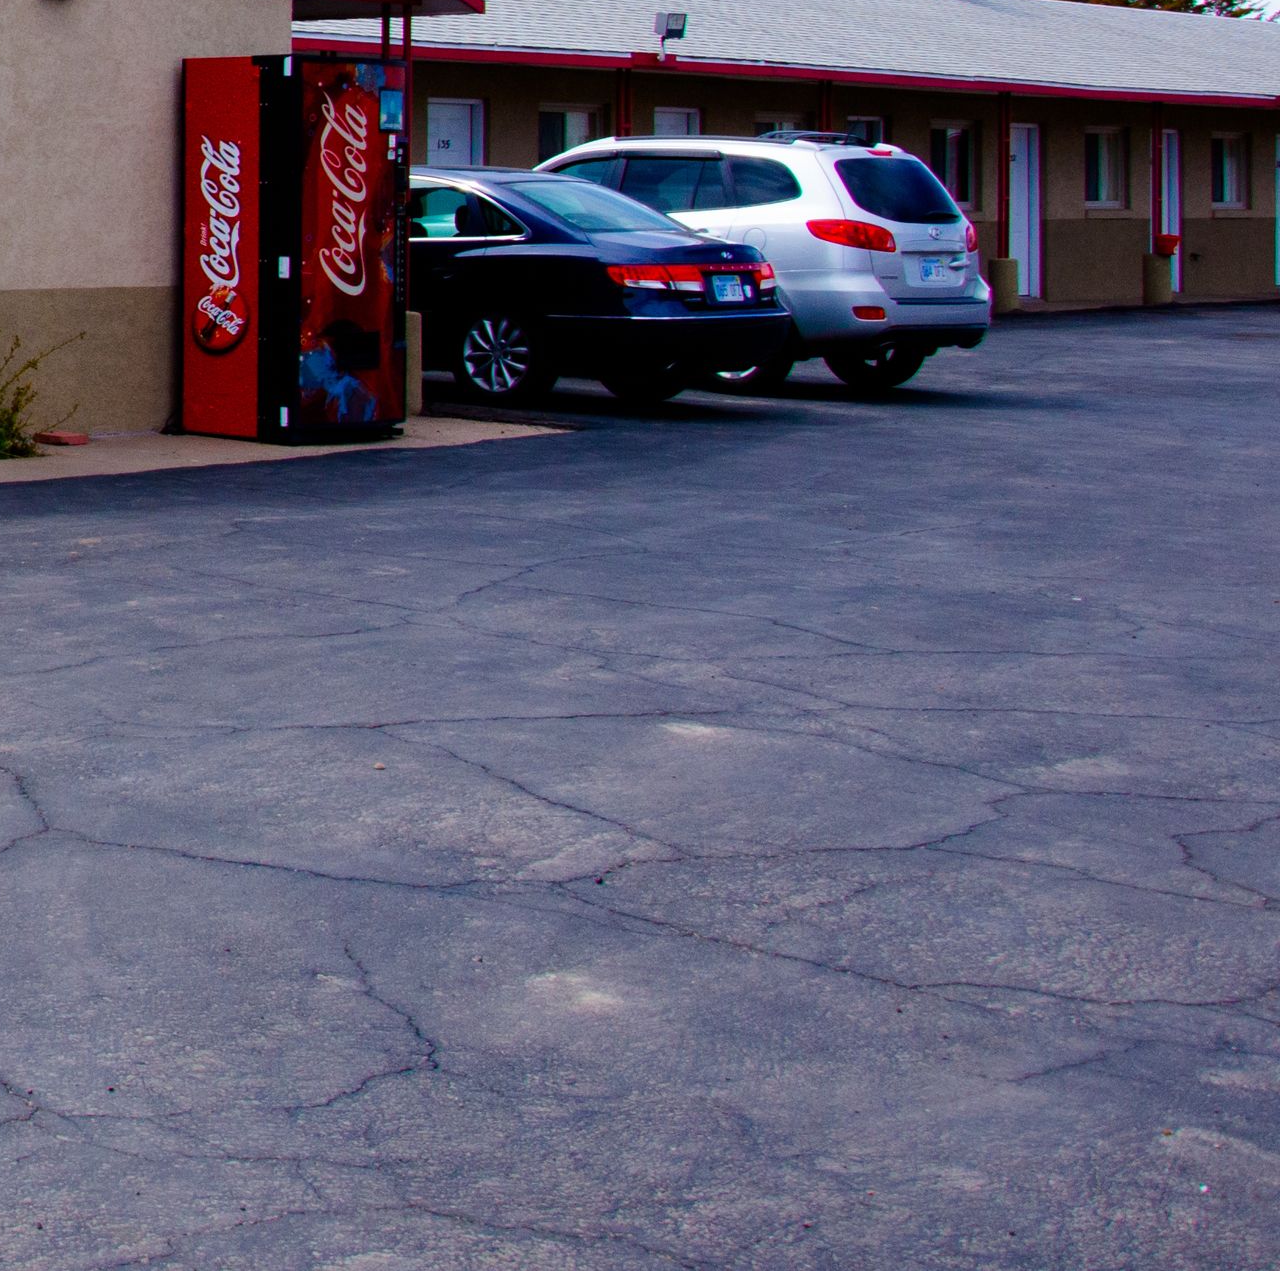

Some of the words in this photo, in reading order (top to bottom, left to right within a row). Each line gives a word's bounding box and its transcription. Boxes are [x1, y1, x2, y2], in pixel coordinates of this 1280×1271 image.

[200, 134, 241, 289] Coca-Cola
[319, 90, 368, 296] Coca-Cola
[197, 295, 245, 335] Coca-Cola
